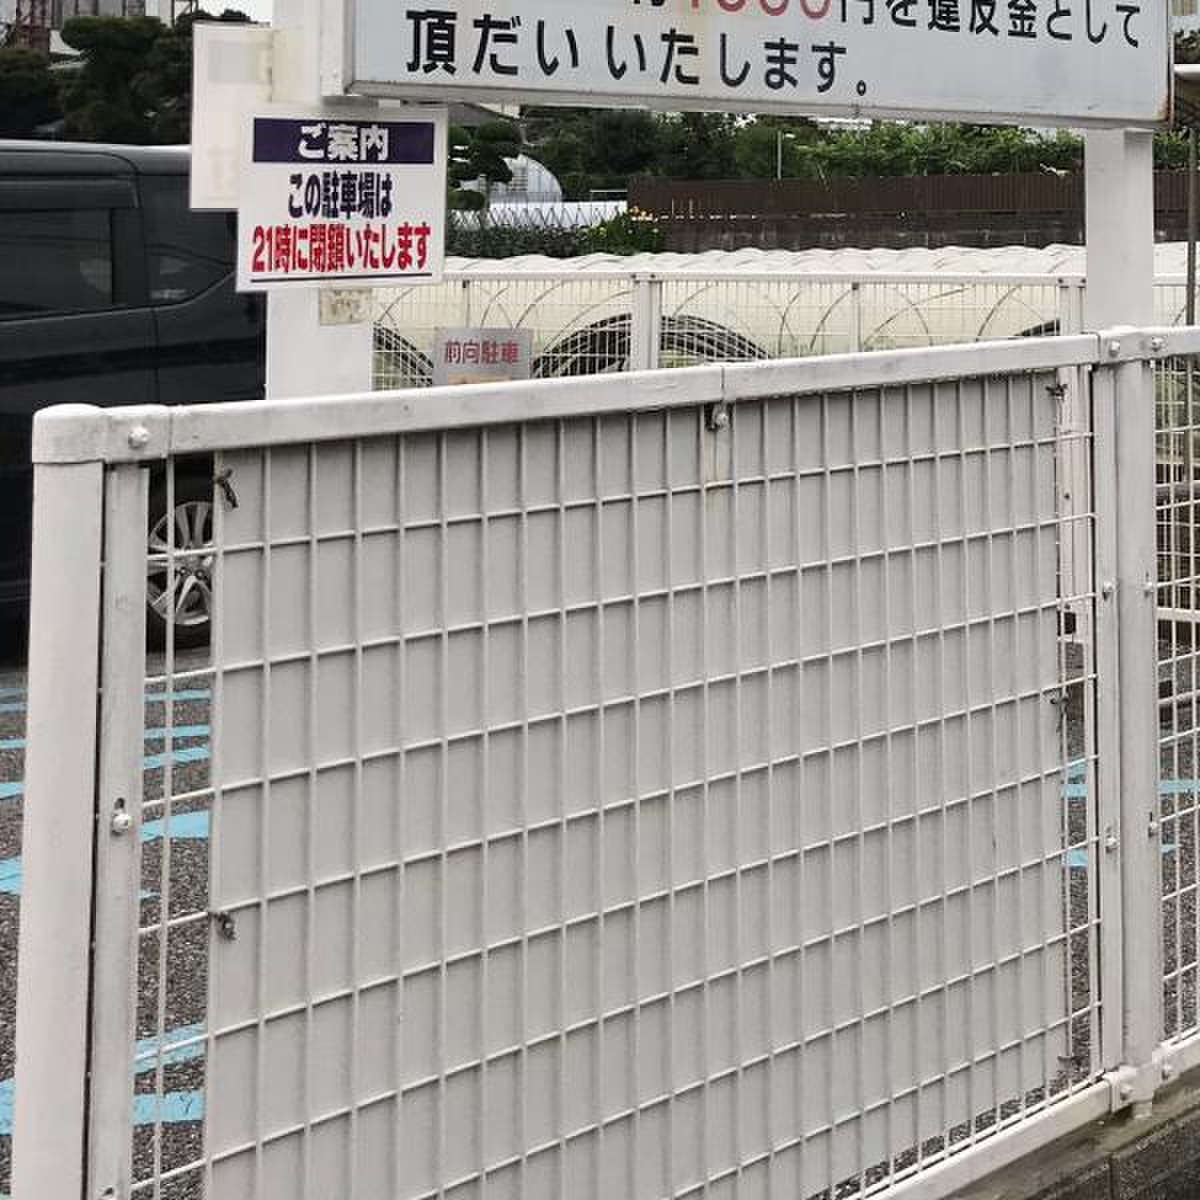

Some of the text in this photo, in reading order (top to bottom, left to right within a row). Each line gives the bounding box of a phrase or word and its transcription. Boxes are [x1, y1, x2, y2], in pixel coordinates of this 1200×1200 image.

[298, 122, 390, 161] ご案内
[288, 170, 393, 219] この駐車場は
[251, 221, 432, 274] 21時に閉鎖いたします
[444, 338, 520, 366] 前向駐車
